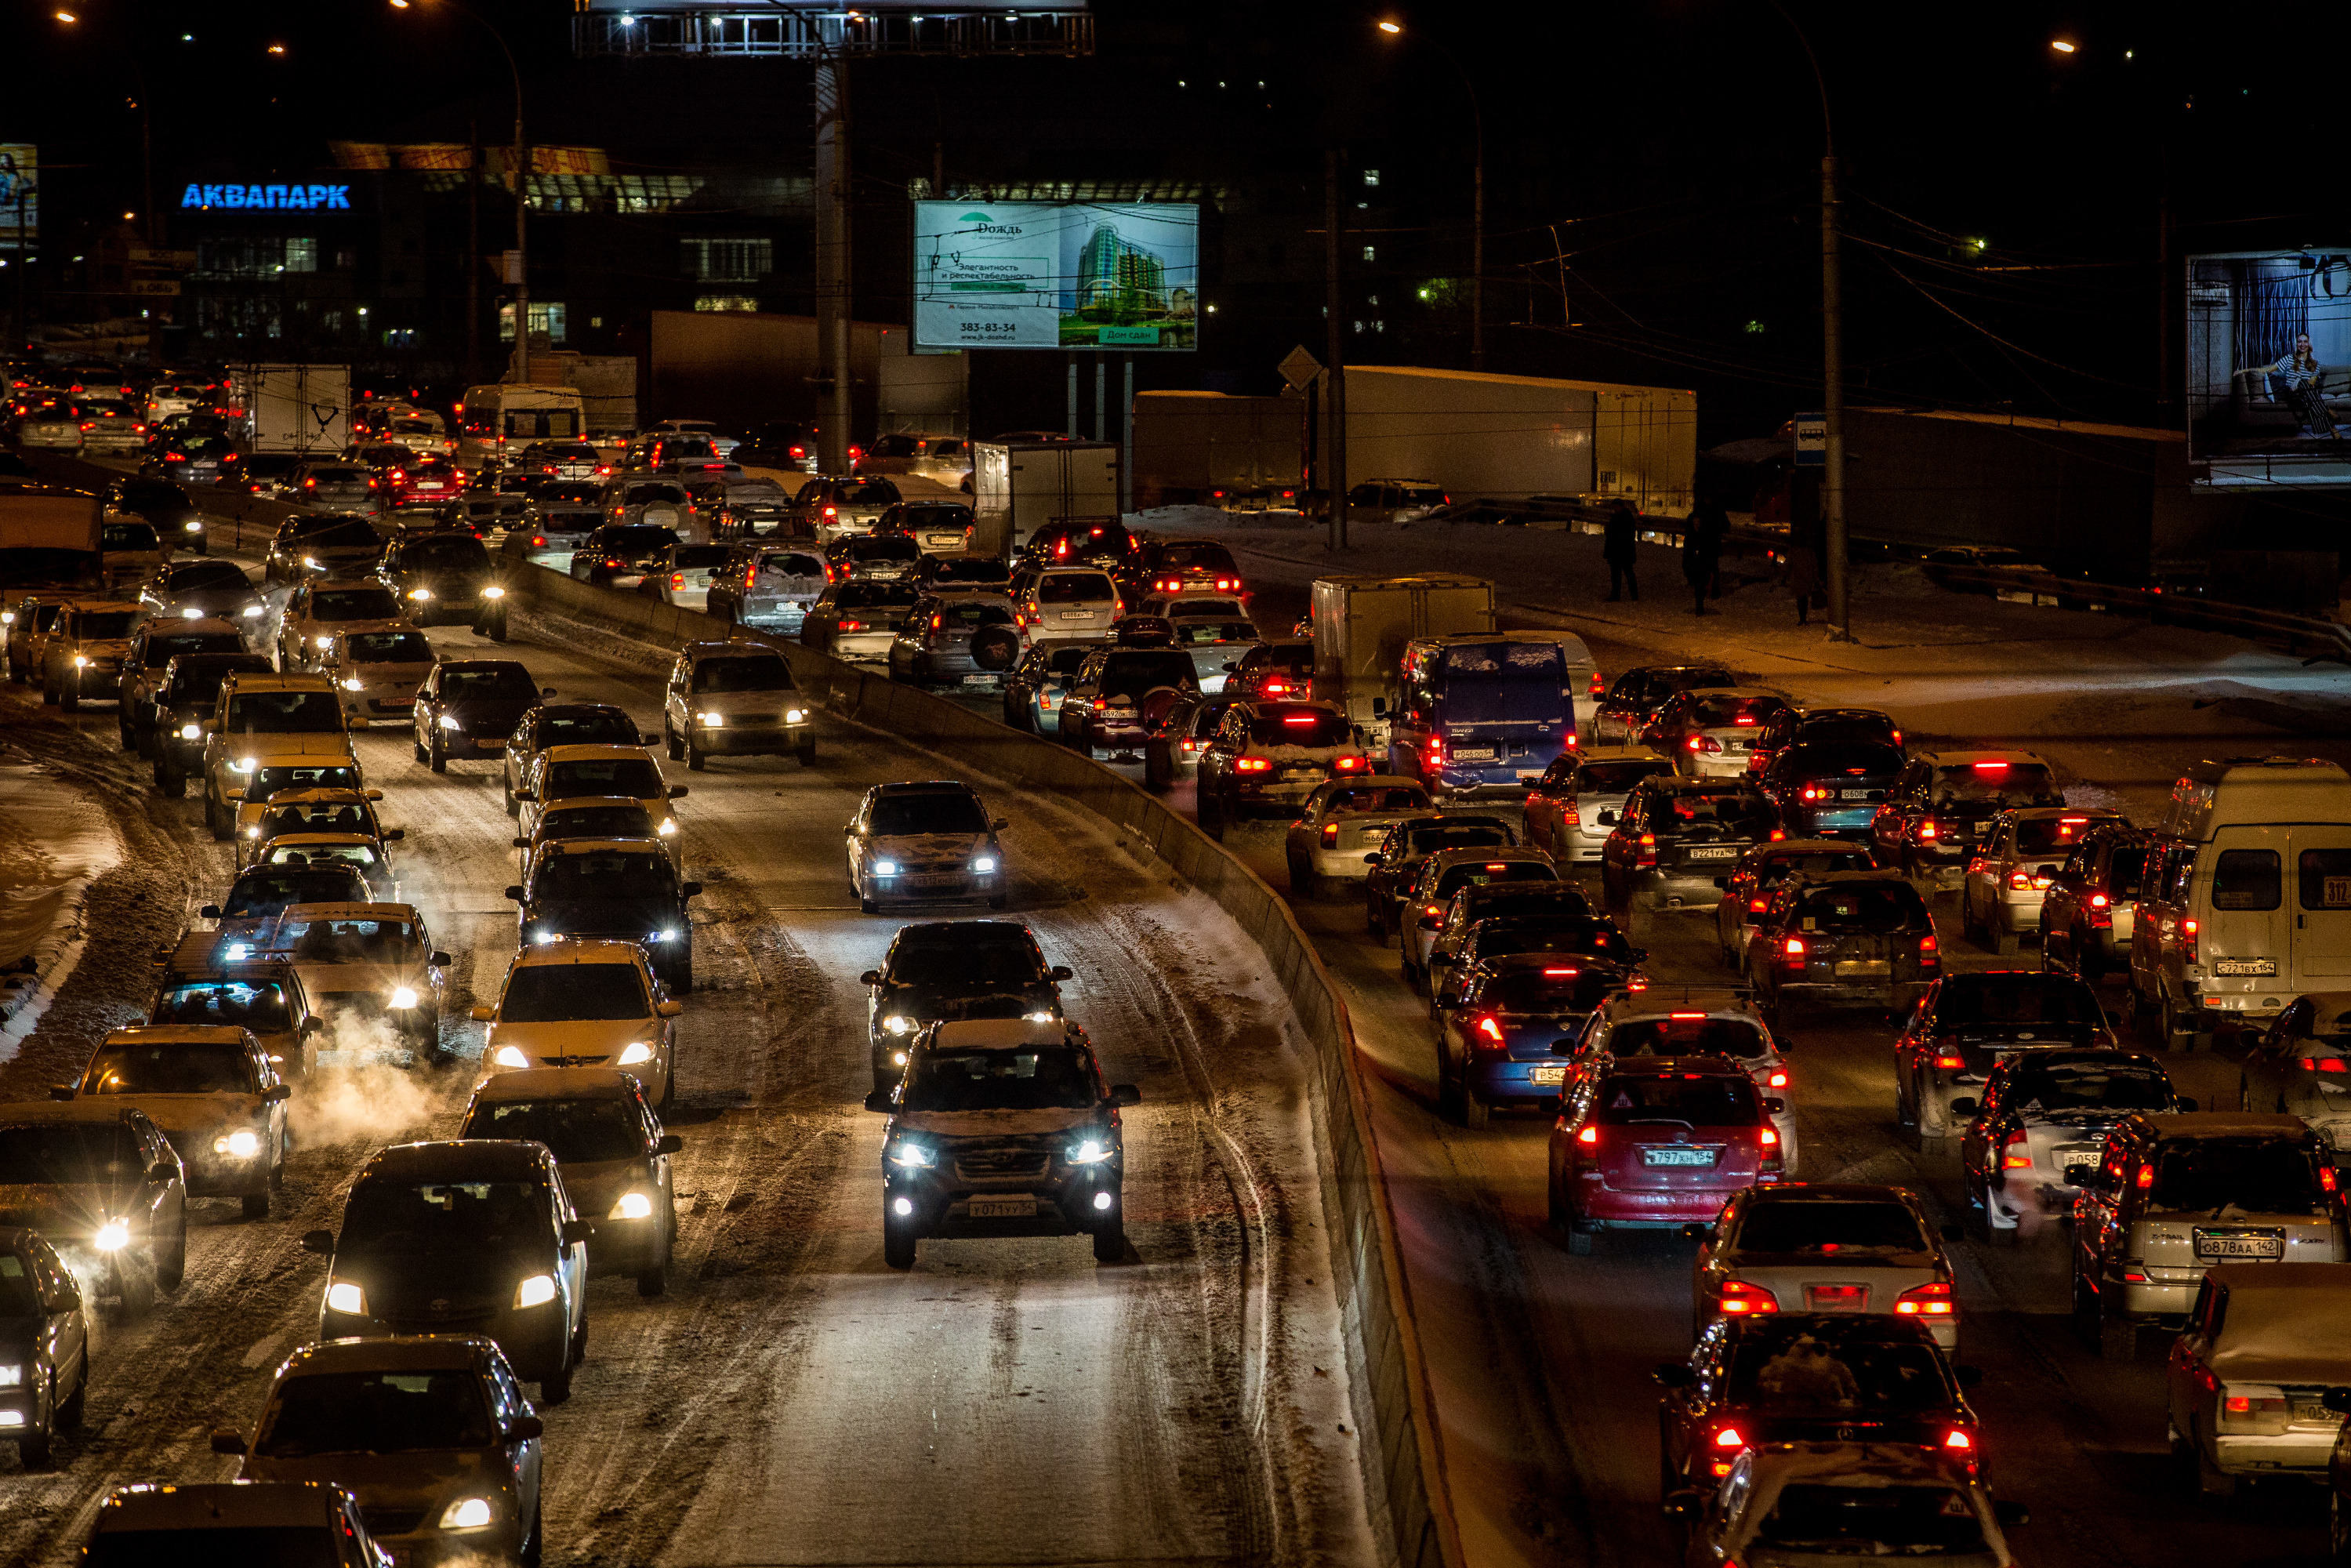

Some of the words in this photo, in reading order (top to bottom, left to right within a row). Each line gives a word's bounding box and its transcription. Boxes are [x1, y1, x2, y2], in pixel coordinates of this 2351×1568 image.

[180, 183, 351, 209] АКВАПАРК
[978, 222, 1022, 235] Дождь
[958, 263, 1018, 272] Элегантность
[949, 272, 1035, 281] респектабельность
[960, 322, 1016, 332] 383-83-34
[960, 333, 1016, 342] www.jk-dozhd.ru
[1106, 330, 1127, 340] Дом
[2328, 881, 2347, 902] 312
[2255, 1241, 2276, 1251] 142
[1950, 1503, 1965, 1512] Ш
